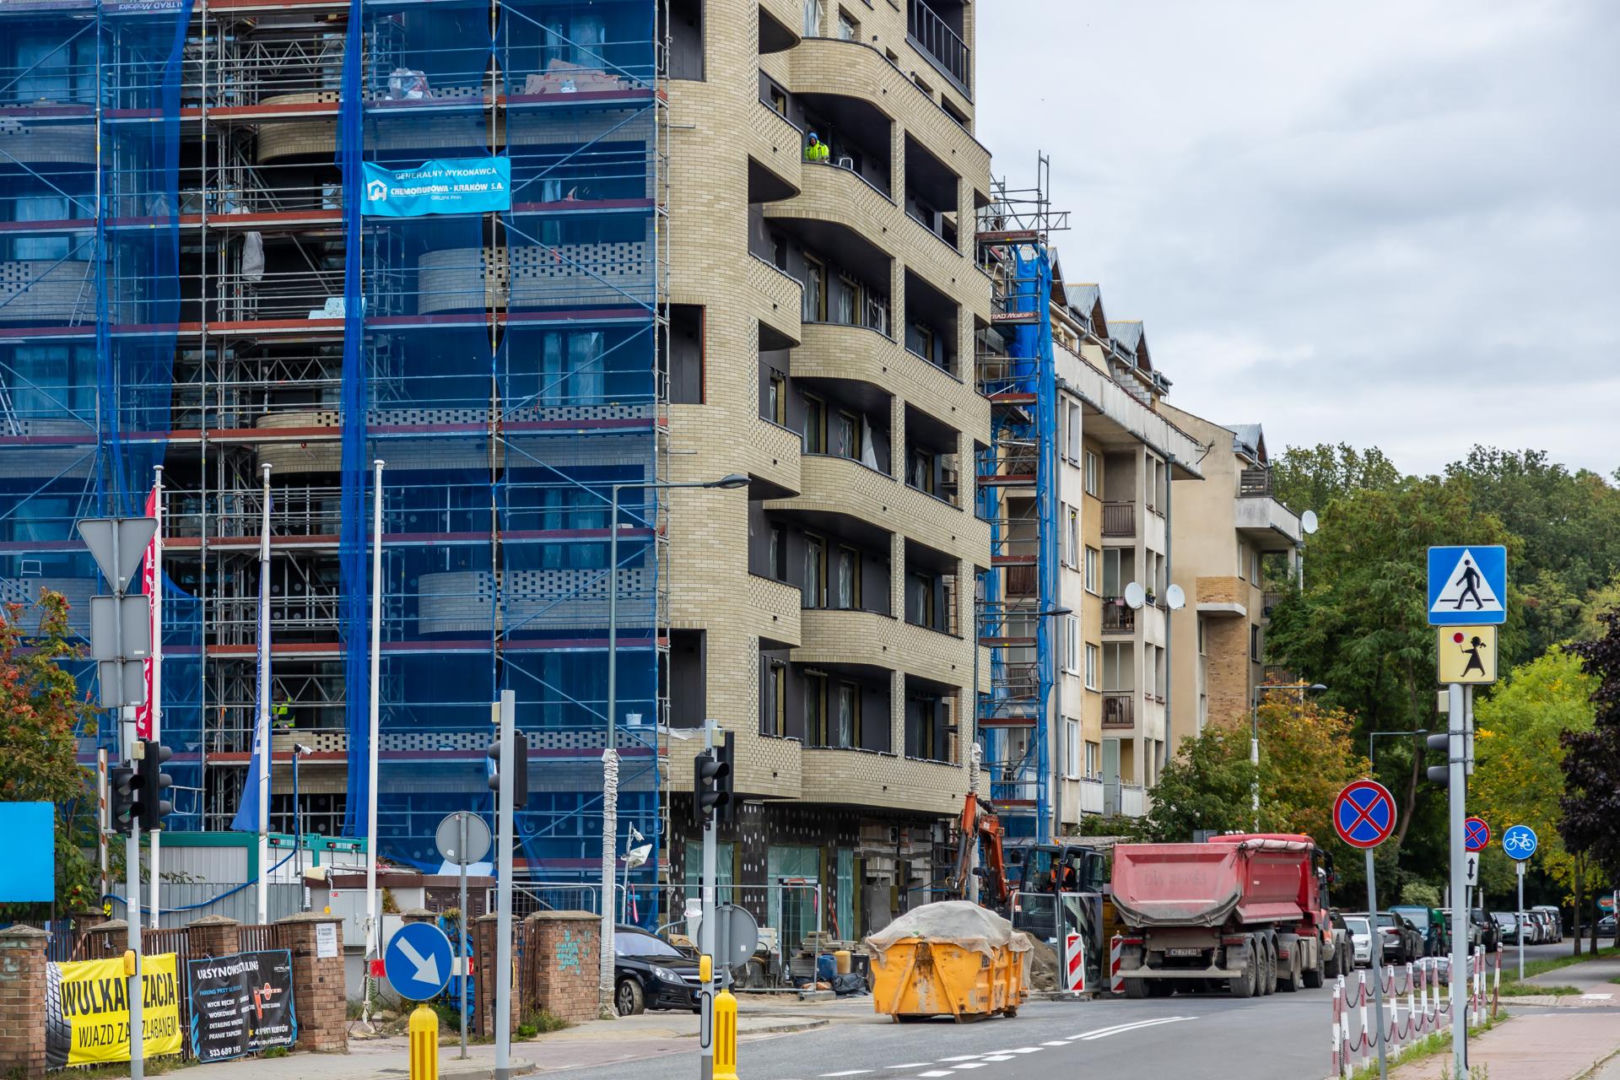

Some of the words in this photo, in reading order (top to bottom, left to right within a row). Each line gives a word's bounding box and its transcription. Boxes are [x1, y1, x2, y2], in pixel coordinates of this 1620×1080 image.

[395, 169, 442, 180] GENERALNY
[445, 168, 497, 177] WYKONAWCA
[453, 183, 488, 192] KRAKÓW
[491, 182, 504, 190] S.A.
[61, 972, 175, 1017] WULKAZACJA
[78, 1024, 114, 1048] WJAZD
[142, 1016, 176, 1040] ZLABANEM
